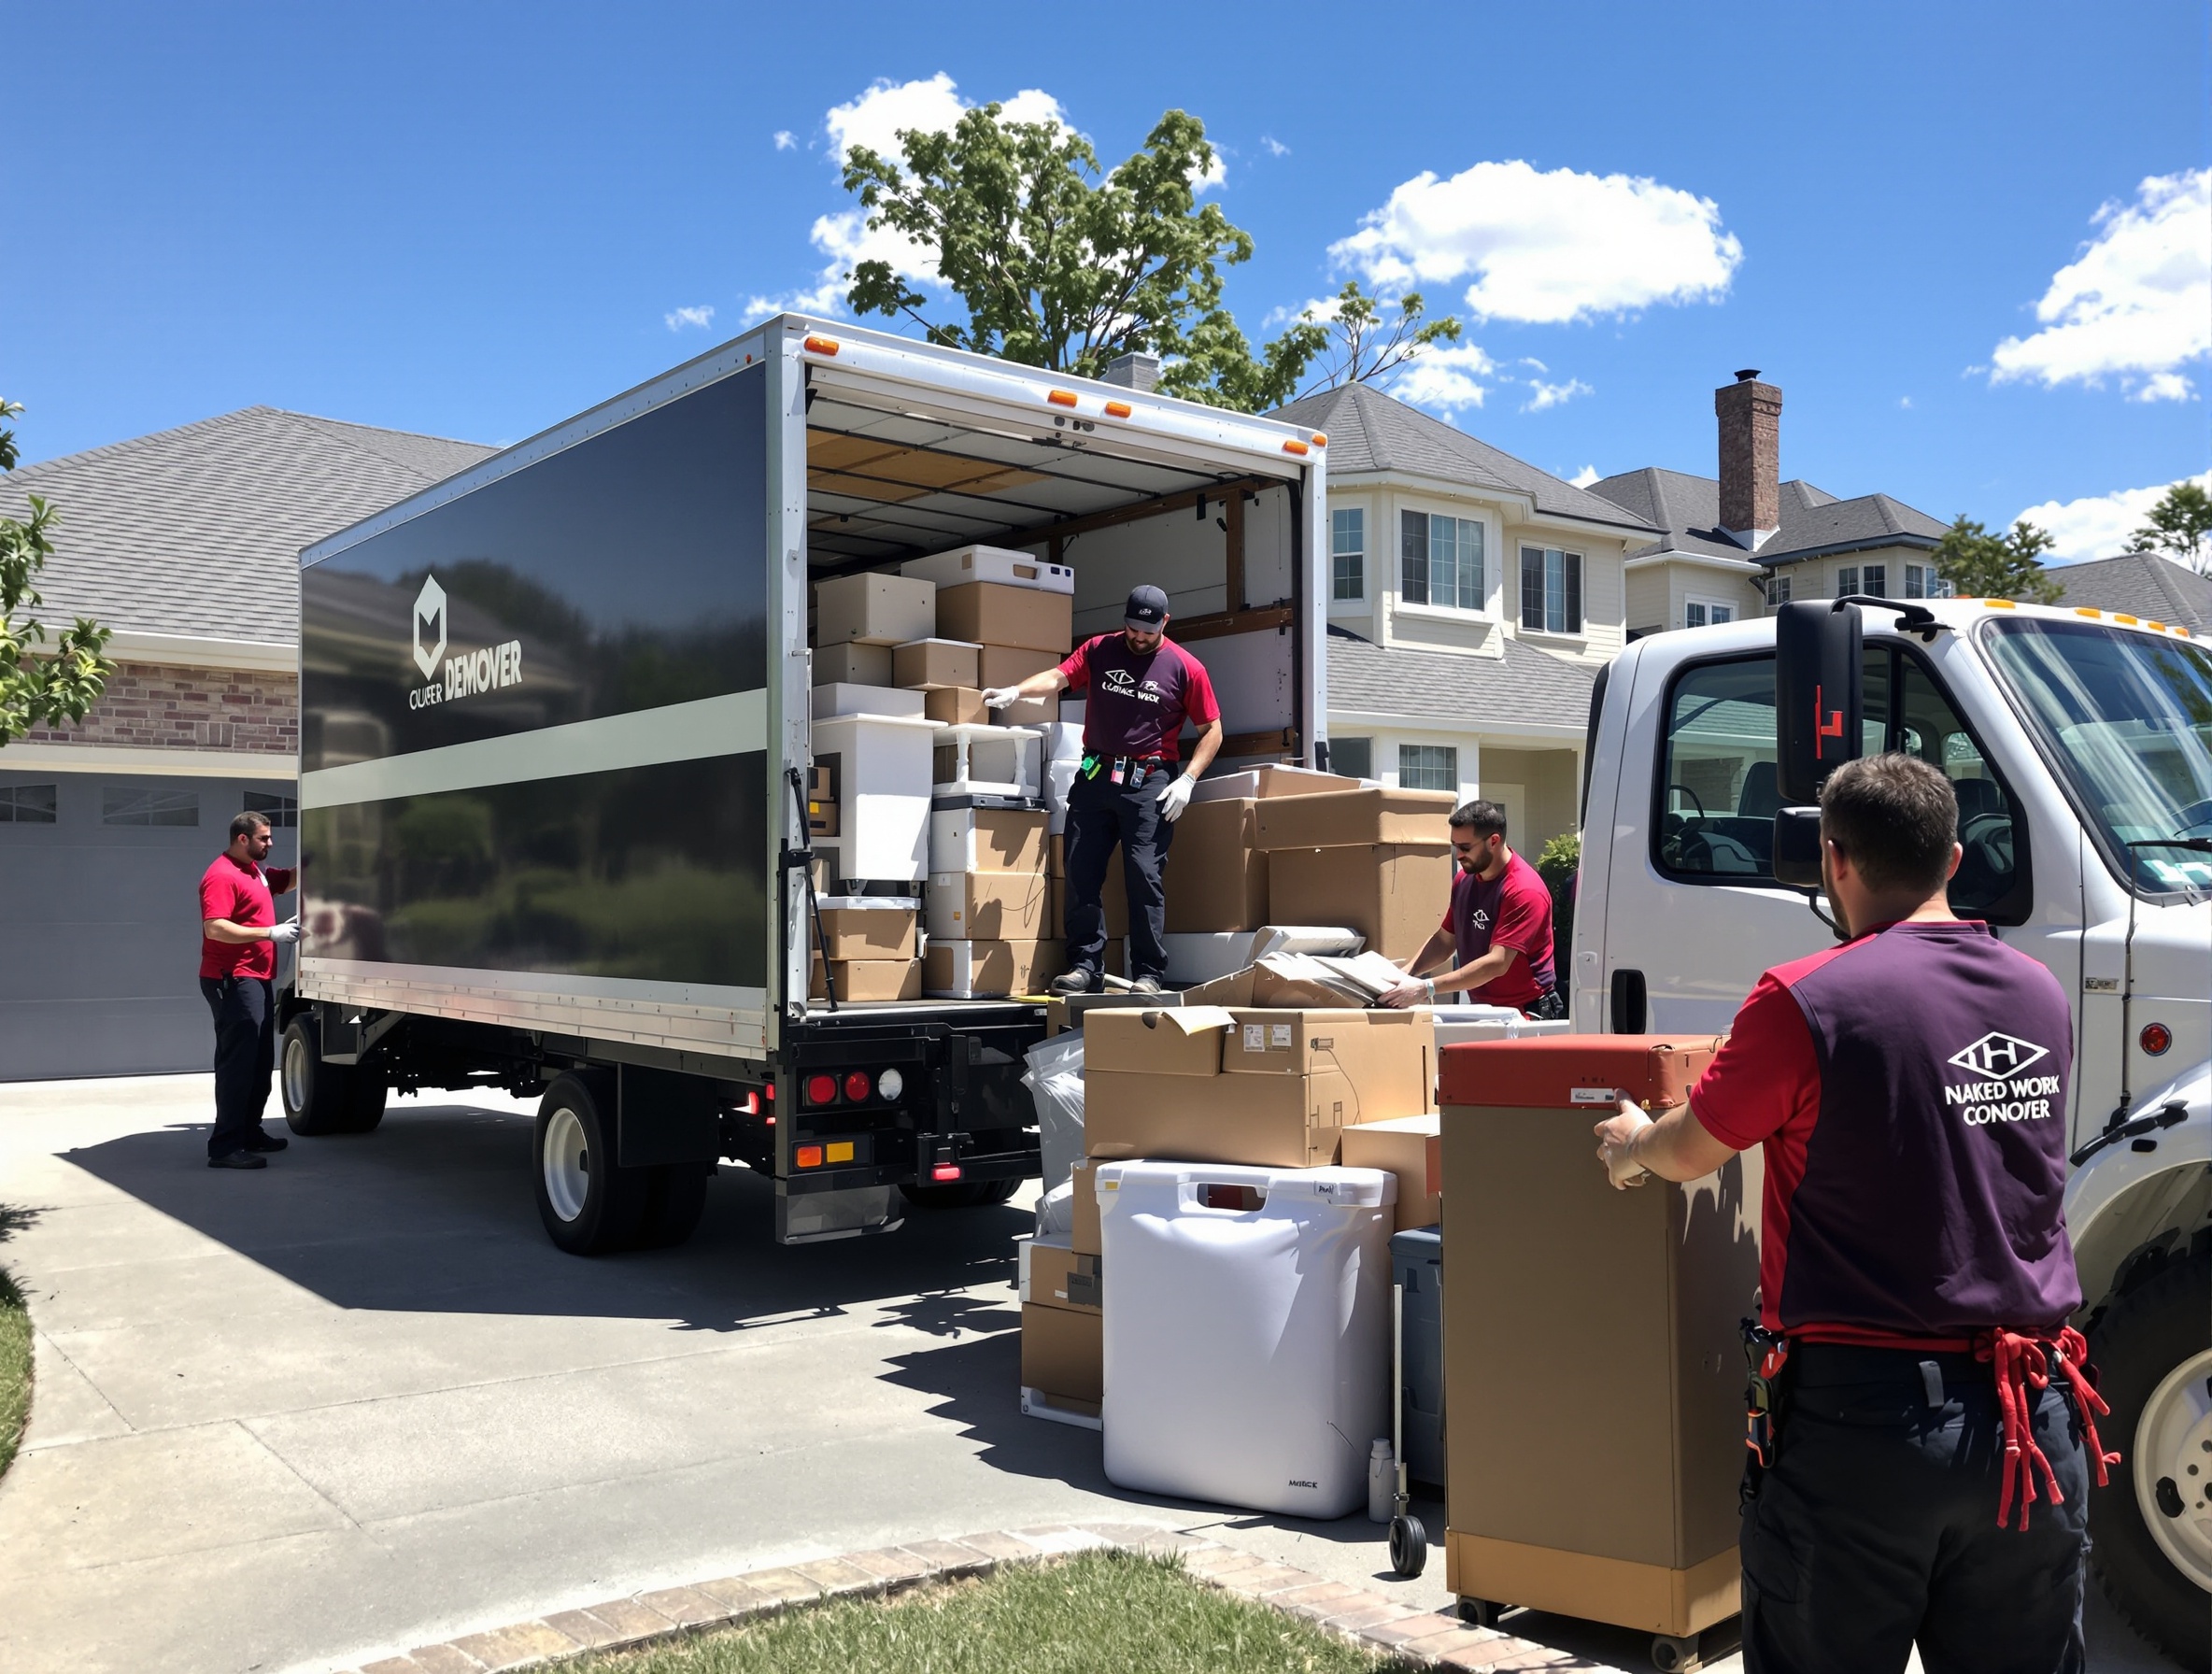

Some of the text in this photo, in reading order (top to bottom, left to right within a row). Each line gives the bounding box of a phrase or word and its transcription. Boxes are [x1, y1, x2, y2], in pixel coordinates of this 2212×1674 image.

[445, 639, 523, 702] DEMOVER
[1945, 1074, 2061, 1105] NAKED WORK
